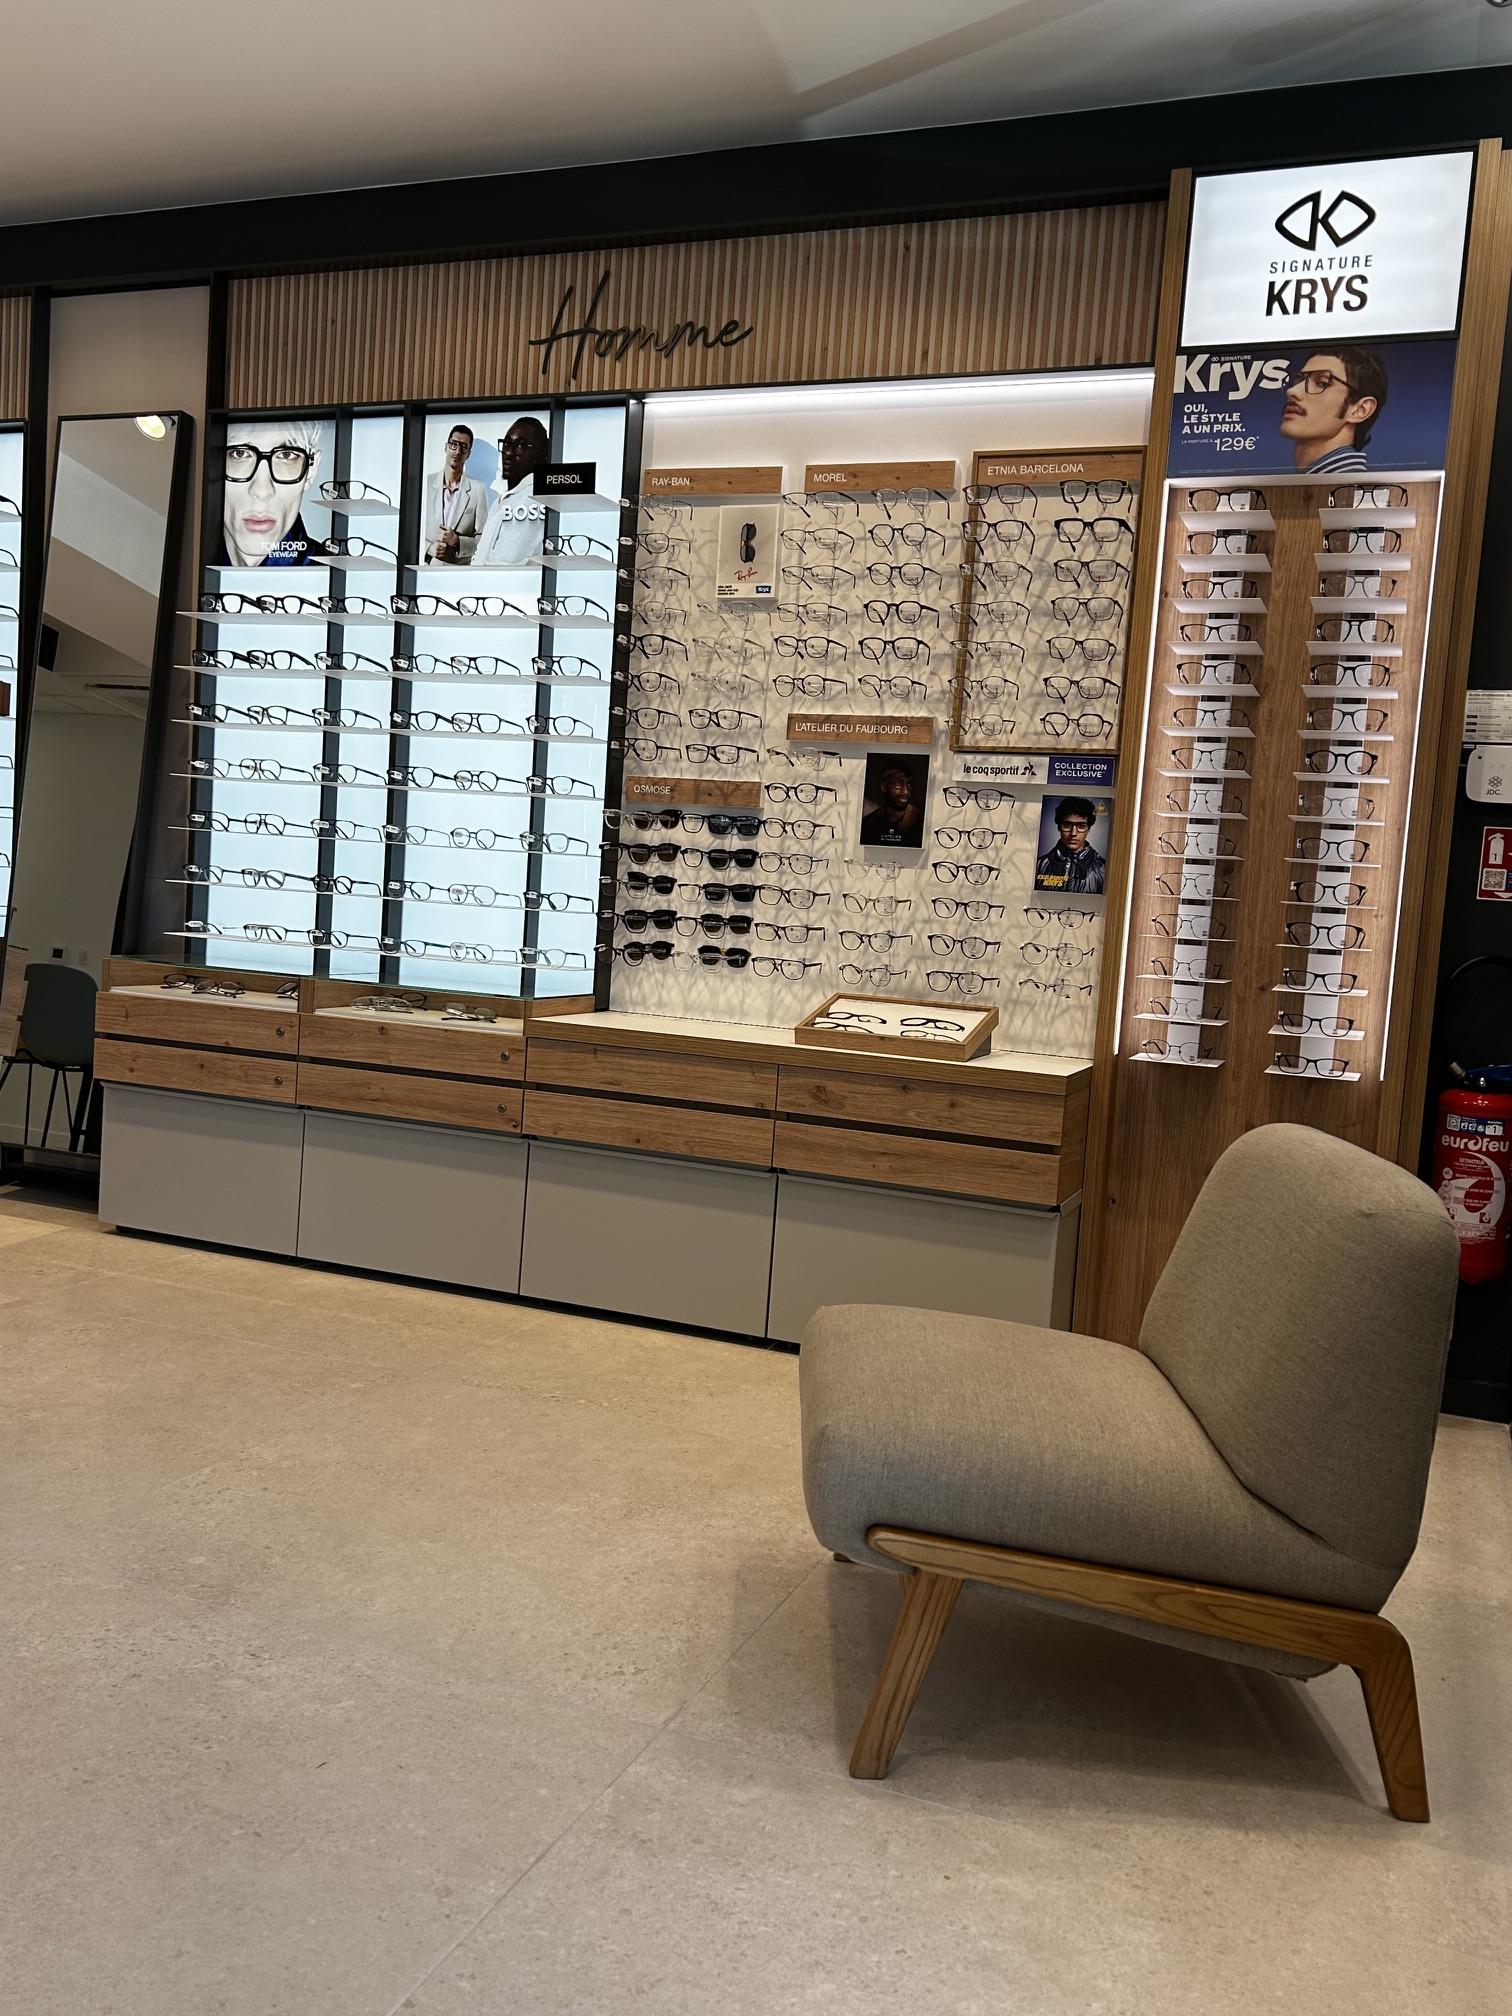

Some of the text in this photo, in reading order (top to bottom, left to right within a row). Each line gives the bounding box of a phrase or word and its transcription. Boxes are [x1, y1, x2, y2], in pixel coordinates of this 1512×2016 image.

[1269, 254, 1374, 275] SIGNATURE
[1265, 273, 1370, 317] KRYS
[528, 269, 754, 380] Homme
[1173, 353, 1291, 401] Krys
[1184, 403, 1208, 414] OUI,
[1183, 412, 1241, 424] LE STYLE
[1193, 424, 1211, 434] UN
[1213, 423, 1246, 433] PRIX.
[987, 463, 1085, 476] ETNIA BARCELONA
[546, 474, 583, 485] PERSOL
[651, 476, 690, 486] RAY-BAN
[813, 473, 847, 483] MOREL
[502, 504, 546, 521] BOSS
[261, 541, 307, 551] TOM FORD
[795, 722, 909, 735] L'ATELIER DU FAUBOURG
[963, 763, 1020, 777] le coq sportif
[1054, 762, 1108, 771] COLLECTION
[633, 784, 671, 795] OSMOSE
[1486, 788, 1500, 796] JDC
[1493, 853, 1498, 861] 1
[1441, 1134, 1510, 1153] eurofeu
